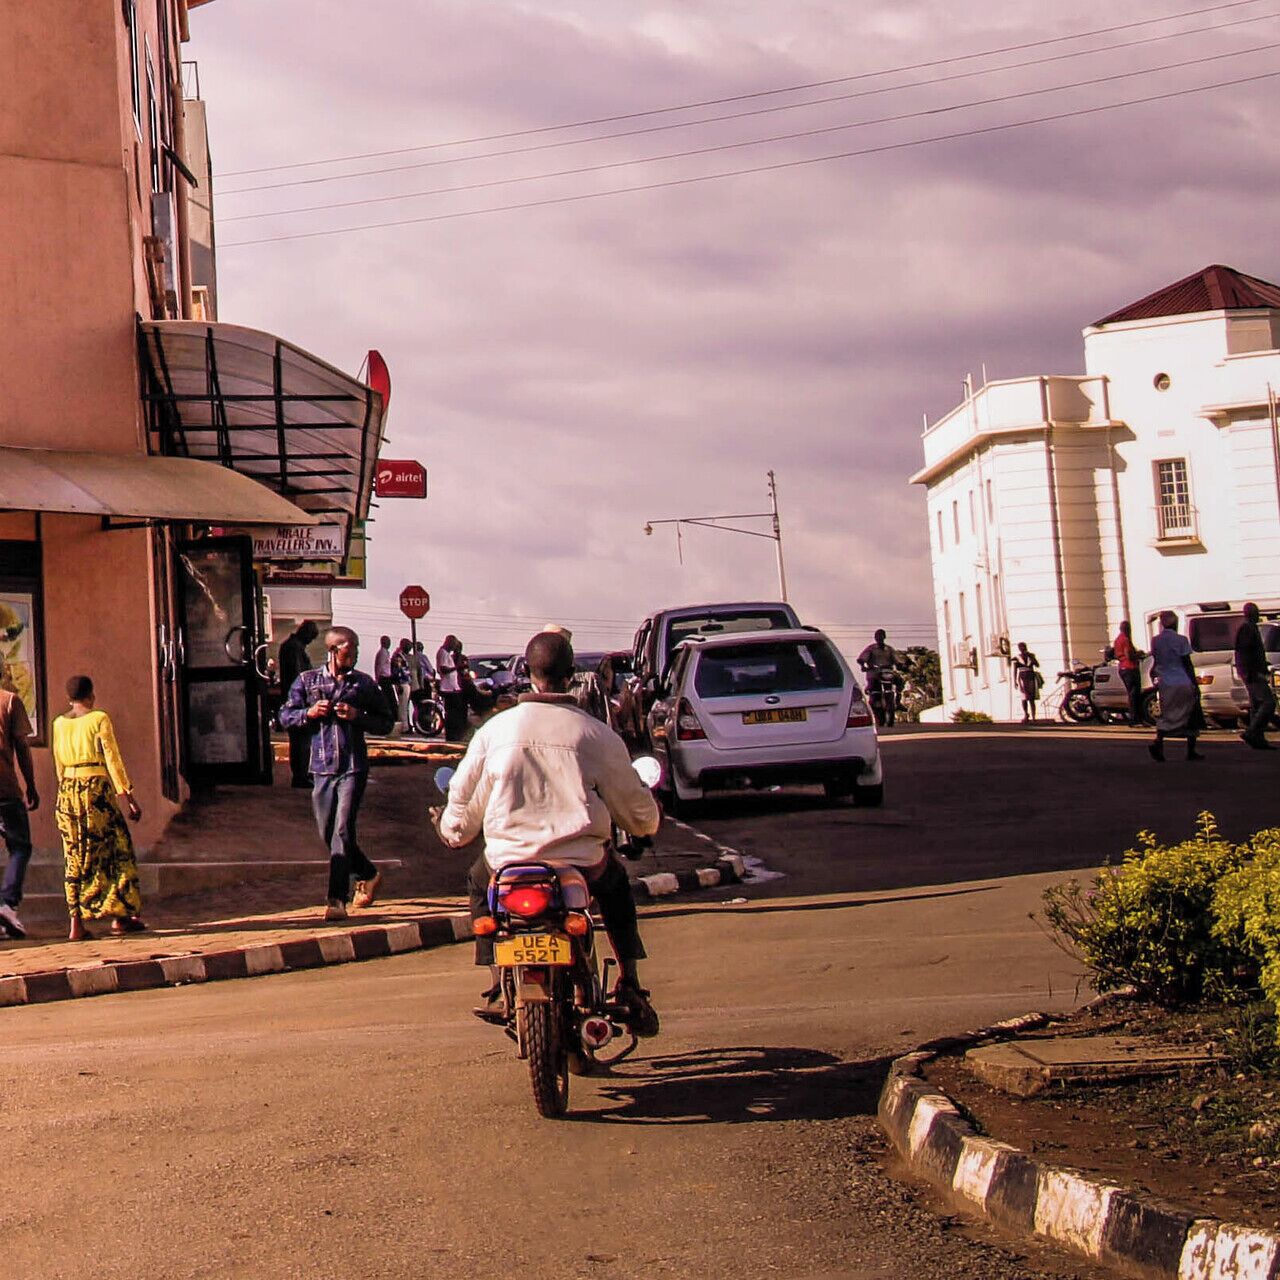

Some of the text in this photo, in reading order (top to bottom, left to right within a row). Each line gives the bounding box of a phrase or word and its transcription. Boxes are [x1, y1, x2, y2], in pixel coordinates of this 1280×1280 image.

[395, 471, 422, 483] airtel
[277, 527, 314, 538] MBALE
[401, 597, 428, 607] STOP
[522, 935, 559, 948] UEA
[513, 949, 560, 962] 552T
